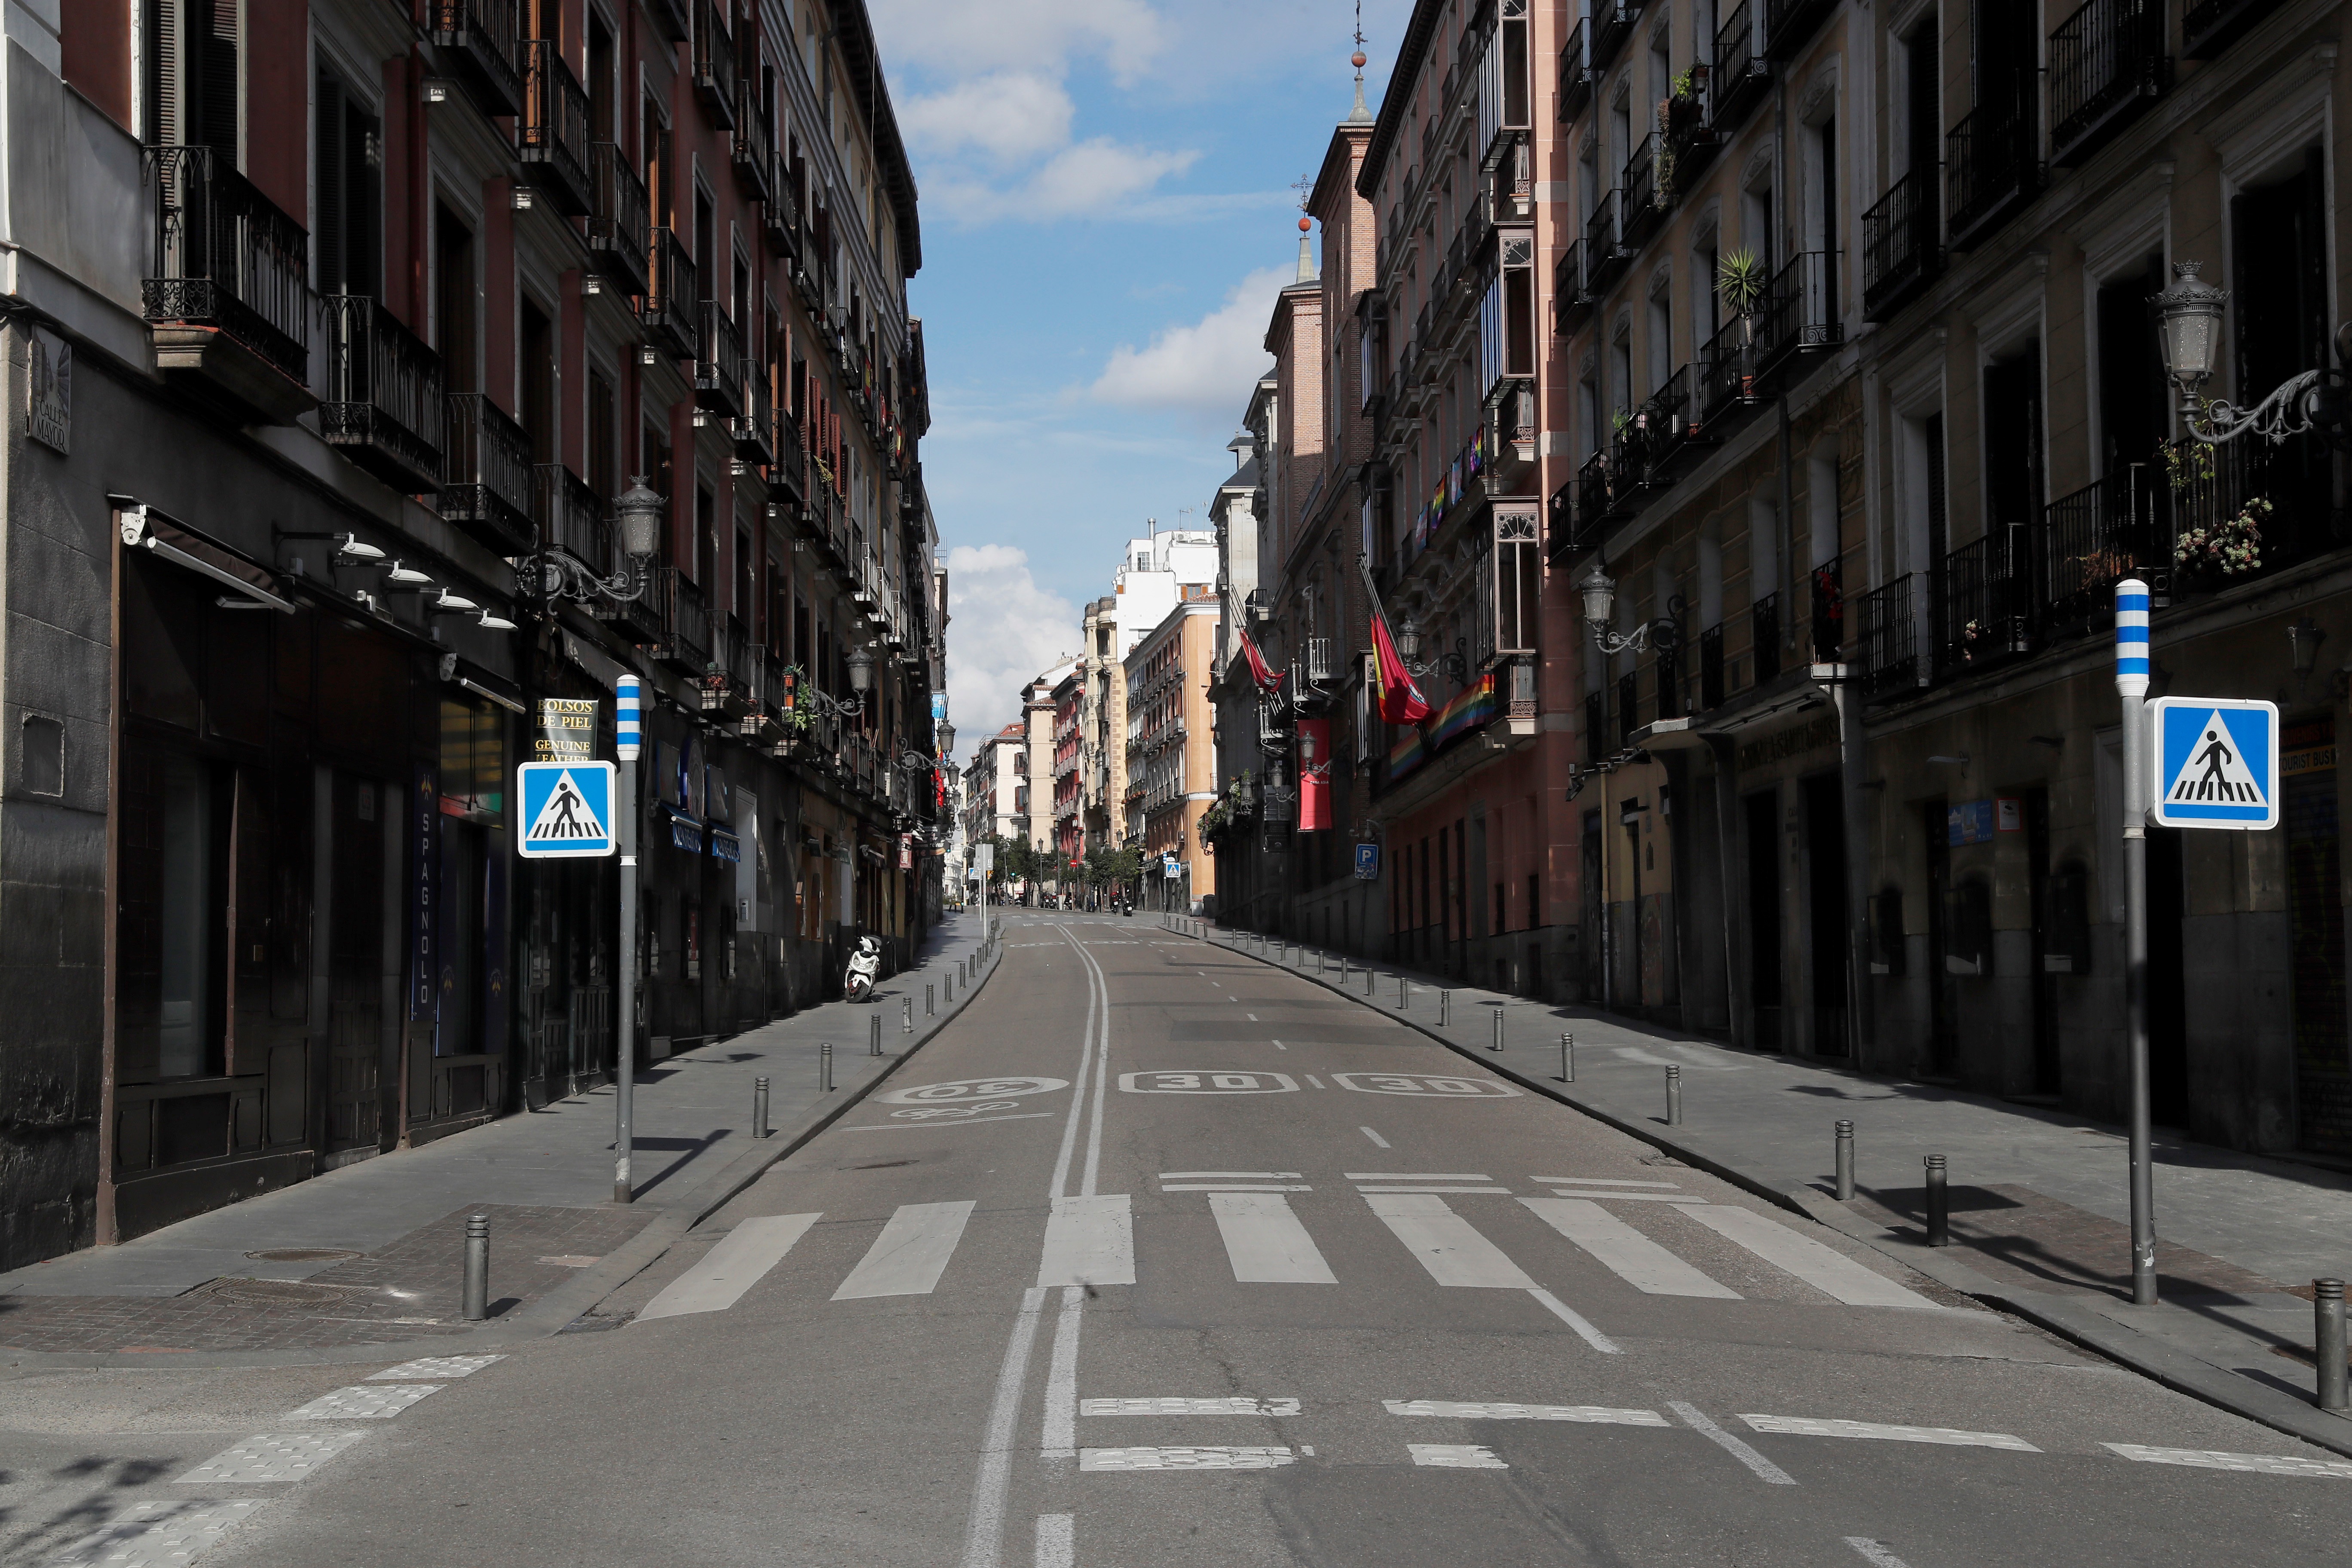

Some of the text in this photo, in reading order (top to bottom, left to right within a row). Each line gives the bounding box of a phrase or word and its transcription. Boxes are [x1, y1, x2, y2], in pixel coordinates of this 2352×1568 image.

[40, 399, 63, 426] CALLE
[37, 416, 66, 452] MAYOR
[538, 700, 592, 712] BOLSOS
[536, 715, 592, 728] DE PIEL
[535, 739, 591, 751] GENUINE
[2280, 750, 2330, 772] OURIST BUS
[1362, 850, 1372, 862] P
[421, 813, 429, 1004] SPAGNOLO
[1156, 1075, 1260, 1089] 30
[1370, 1077, 1483, 1093] 30
